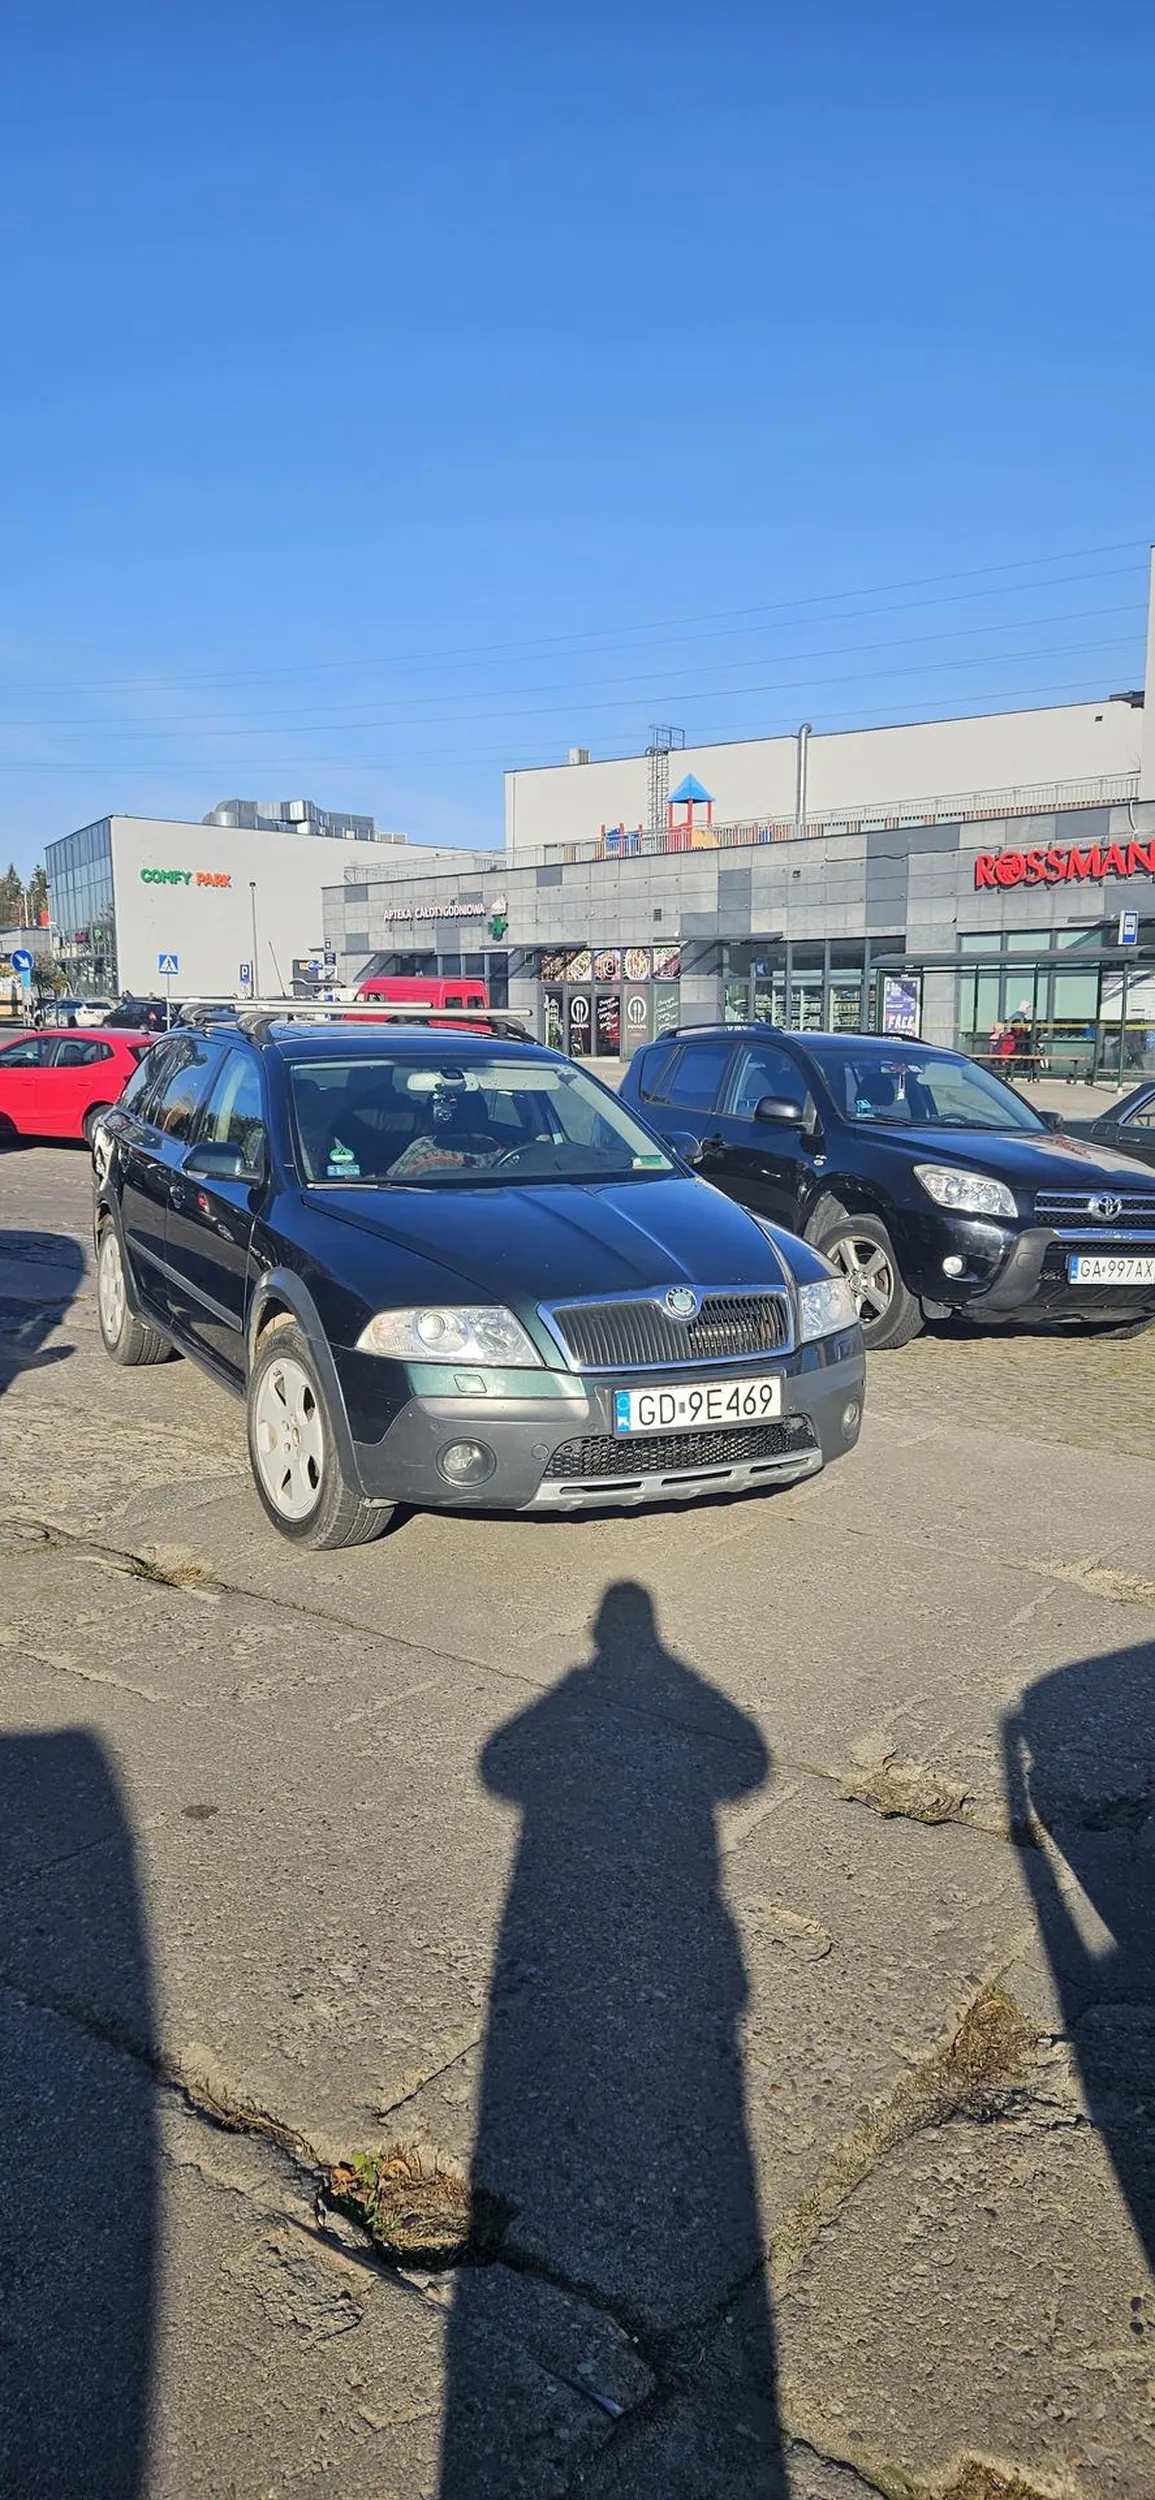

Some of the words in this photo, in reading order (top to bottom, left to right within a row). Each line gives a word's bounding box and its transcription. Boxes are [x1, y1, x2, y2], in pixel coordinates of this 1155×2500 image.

[140, 868, 192, 885] COMFY
[196, 872, 232, 888] PARK
[383, 907, 413, 921] APTEKA
[1081, 1259, 1101, 1278] GA
[1107, 1259, 1153, 1278] 997AX
[639, 1394, 676, 1426] GD
[688, 1384, 773, 1422] 9E469
